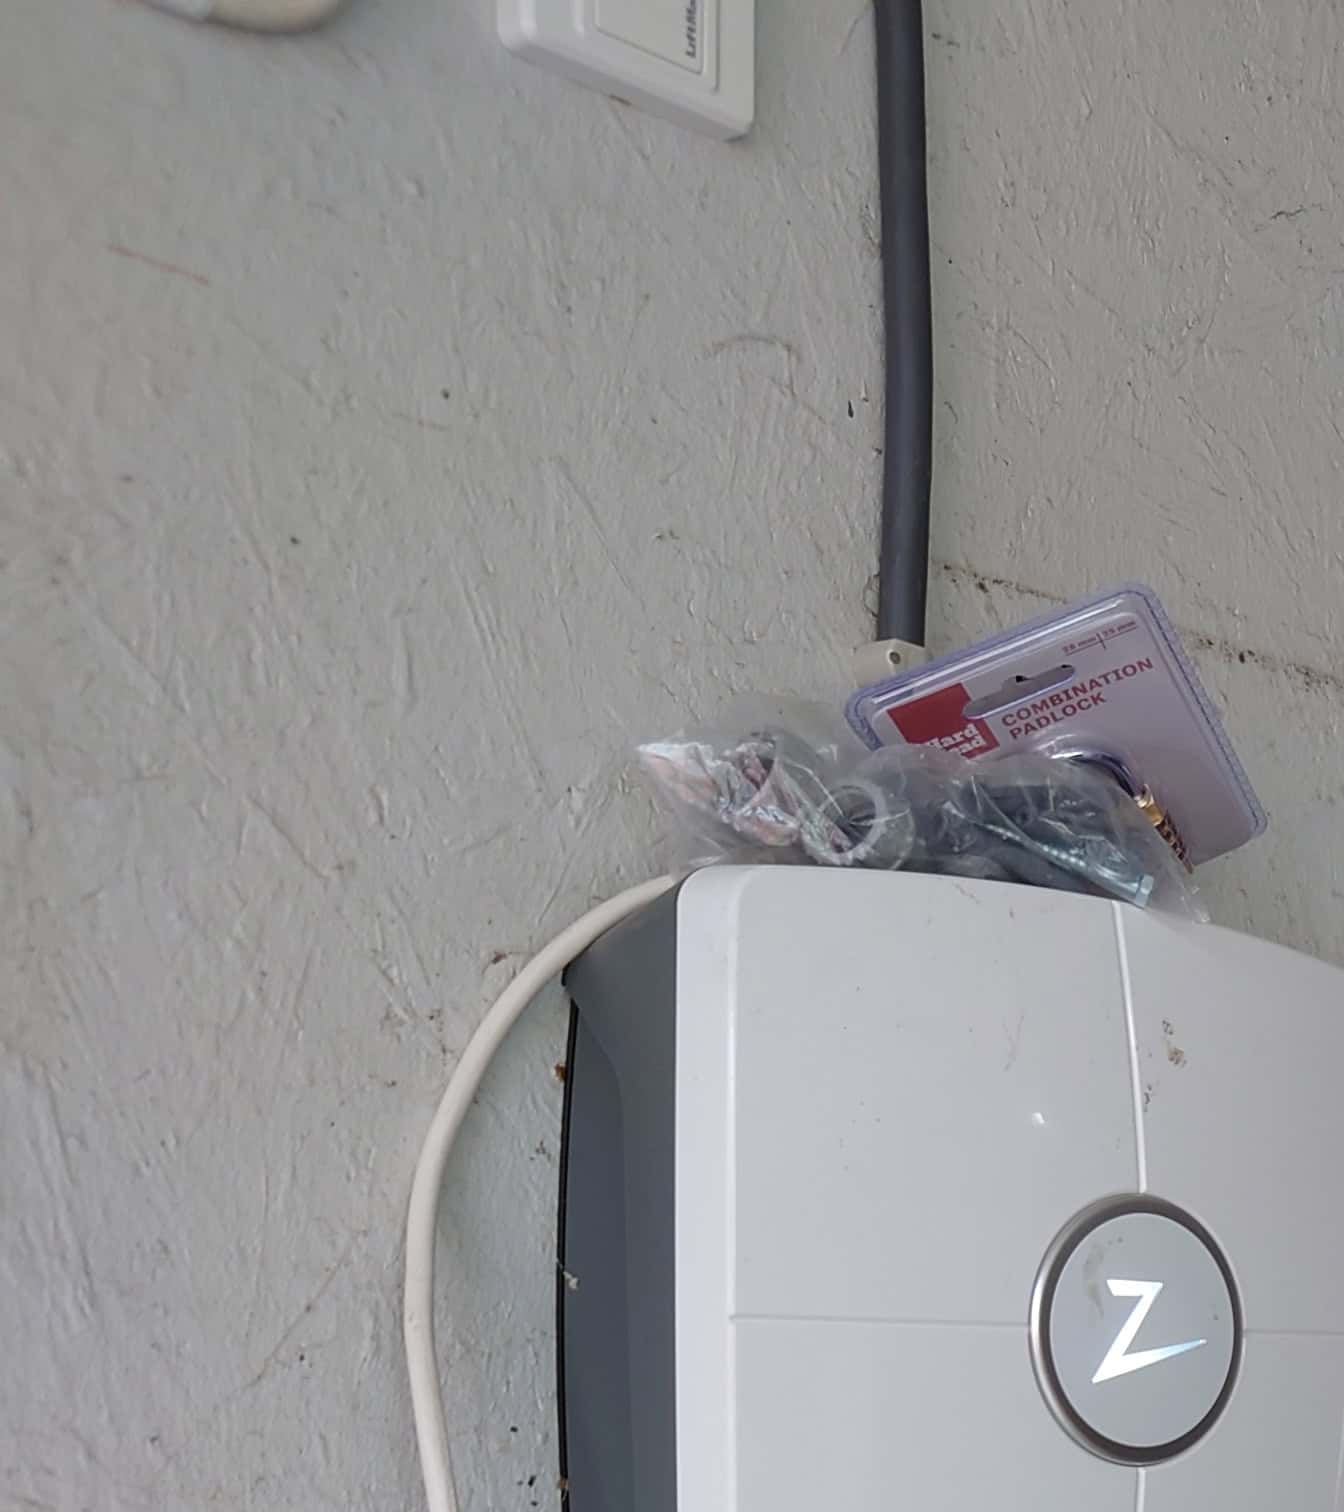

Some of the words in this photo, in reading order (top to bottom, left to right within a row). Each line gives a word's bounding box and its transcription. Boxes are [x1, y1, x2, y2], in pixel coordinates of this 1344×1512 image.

[1001, 658, 1153, 727] COMBINATION
[1008, 693, 1107, 740] PADLOCK
[1092, 1279, 1208, 1384] Z
